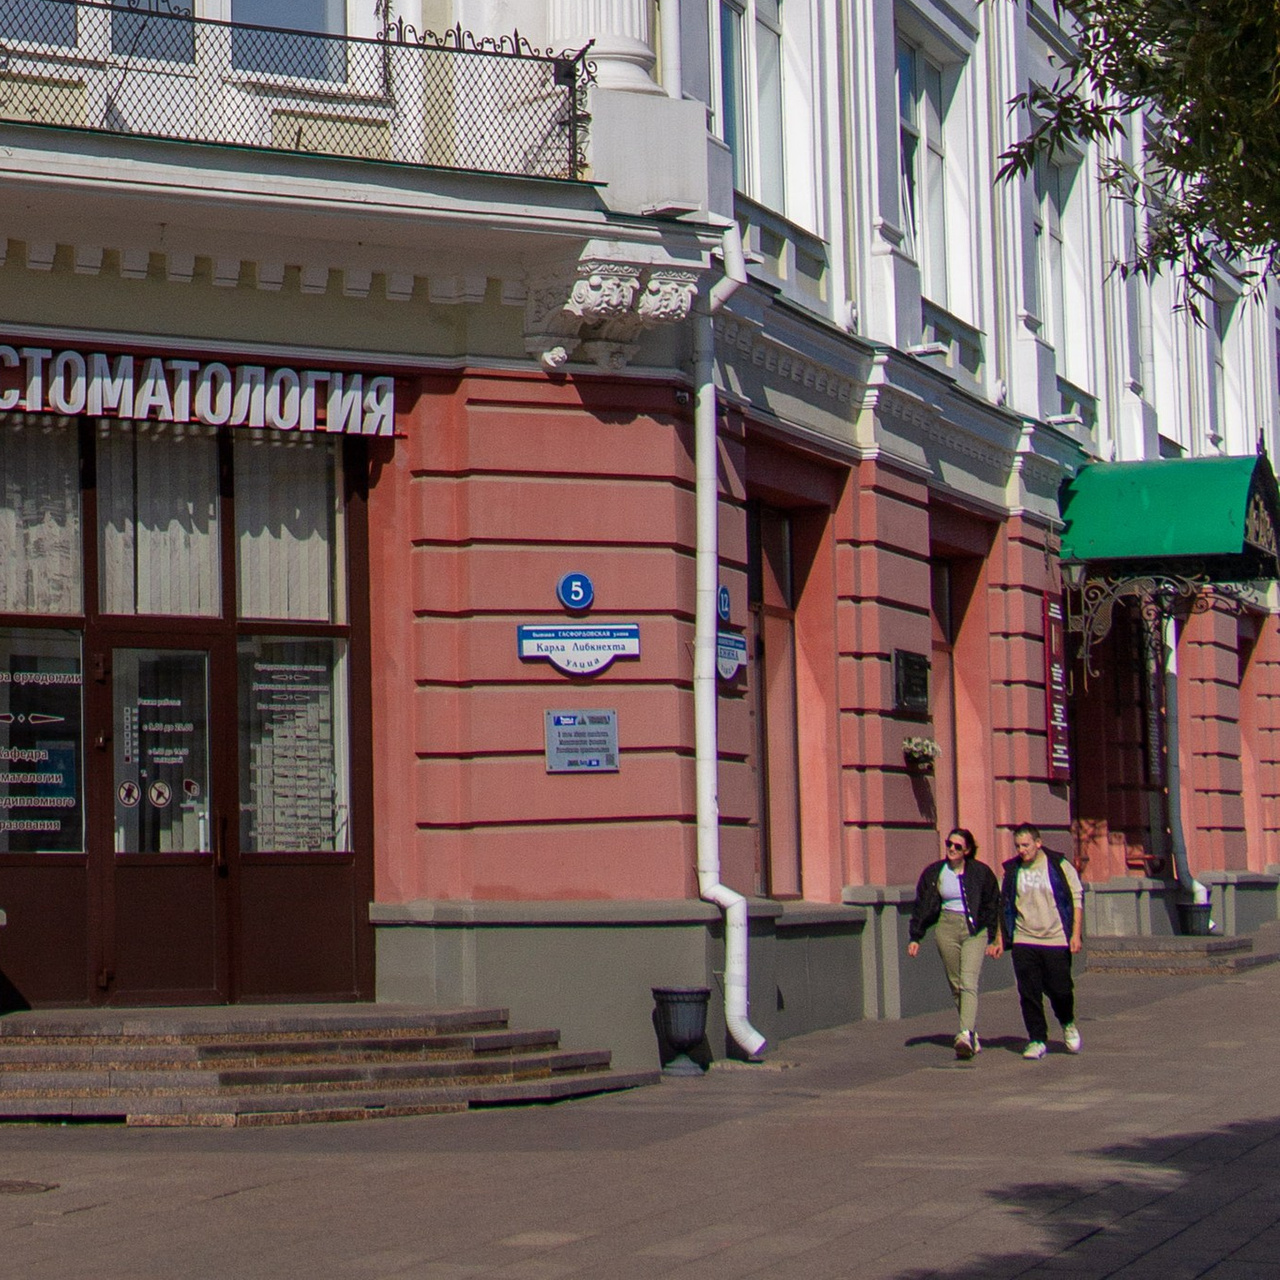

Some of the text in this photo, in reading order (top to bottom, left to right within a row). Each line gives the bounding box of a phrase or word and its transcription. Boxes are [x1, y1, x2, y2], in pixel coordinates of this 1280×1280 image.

[571, 581, 584, 601] 5
[720, 593, 729, 611] 12
[536, 642, 626, 654] Карла Либкнехта
[565, 657, 600, 668] улица
[13, 671, 82, 685] ортодонтии
